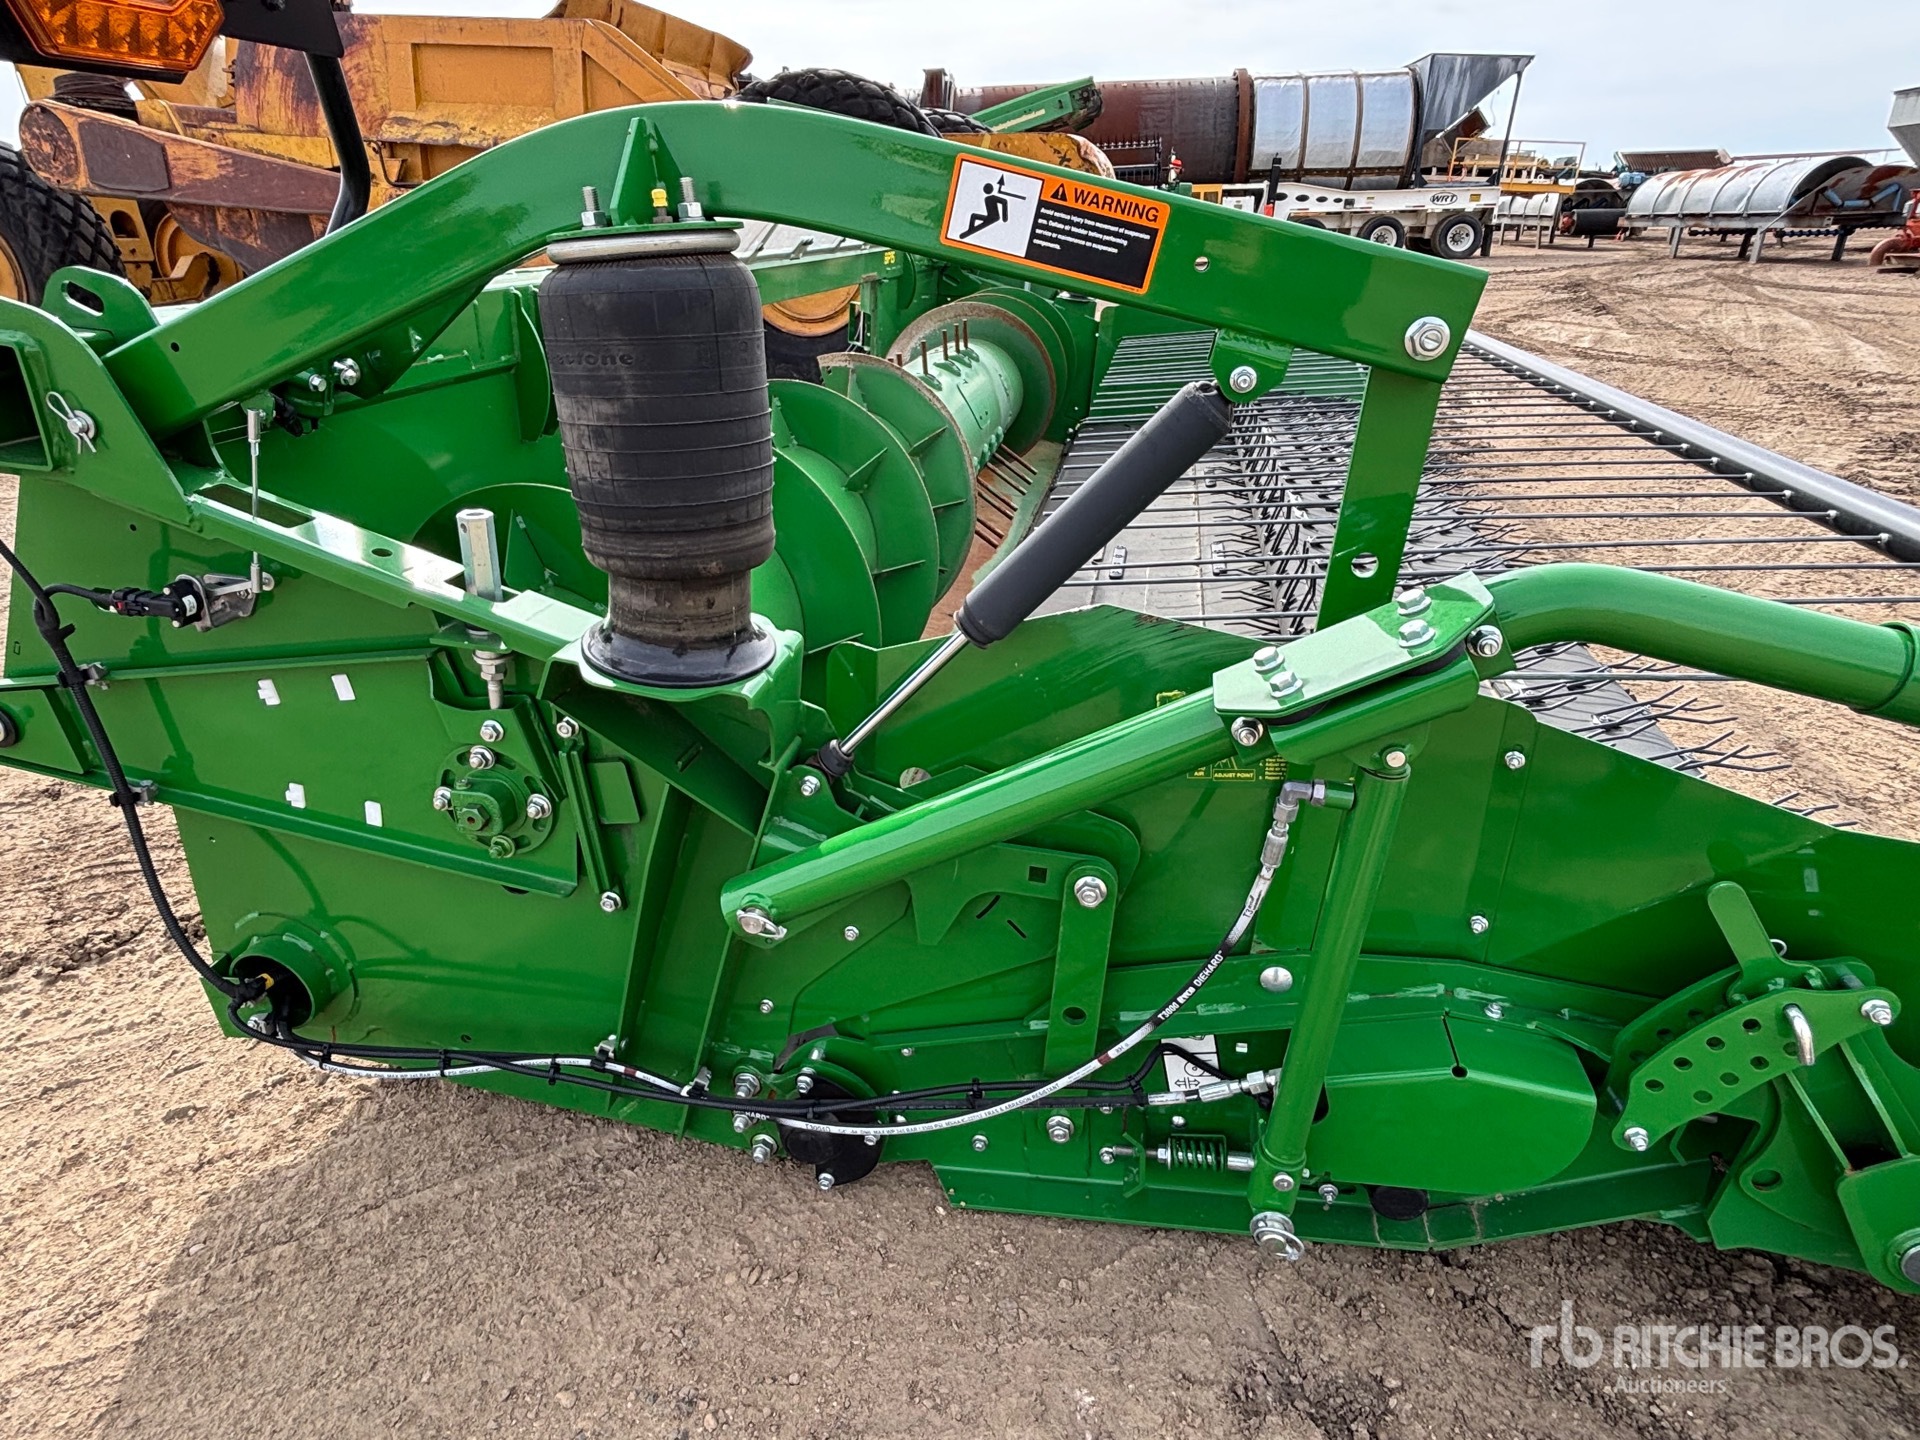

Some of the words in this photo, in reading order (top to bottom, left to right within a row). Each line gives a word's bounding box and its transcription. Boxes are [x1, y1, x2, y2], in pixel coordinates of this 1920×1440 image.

[1073, 187, 1159, 223] WARNING
[1431, 193, 1457, 204] WRT
[1157, 1002, 1180, 1021] T3000
[1193, 954, 1224, 987] DIEHARD
